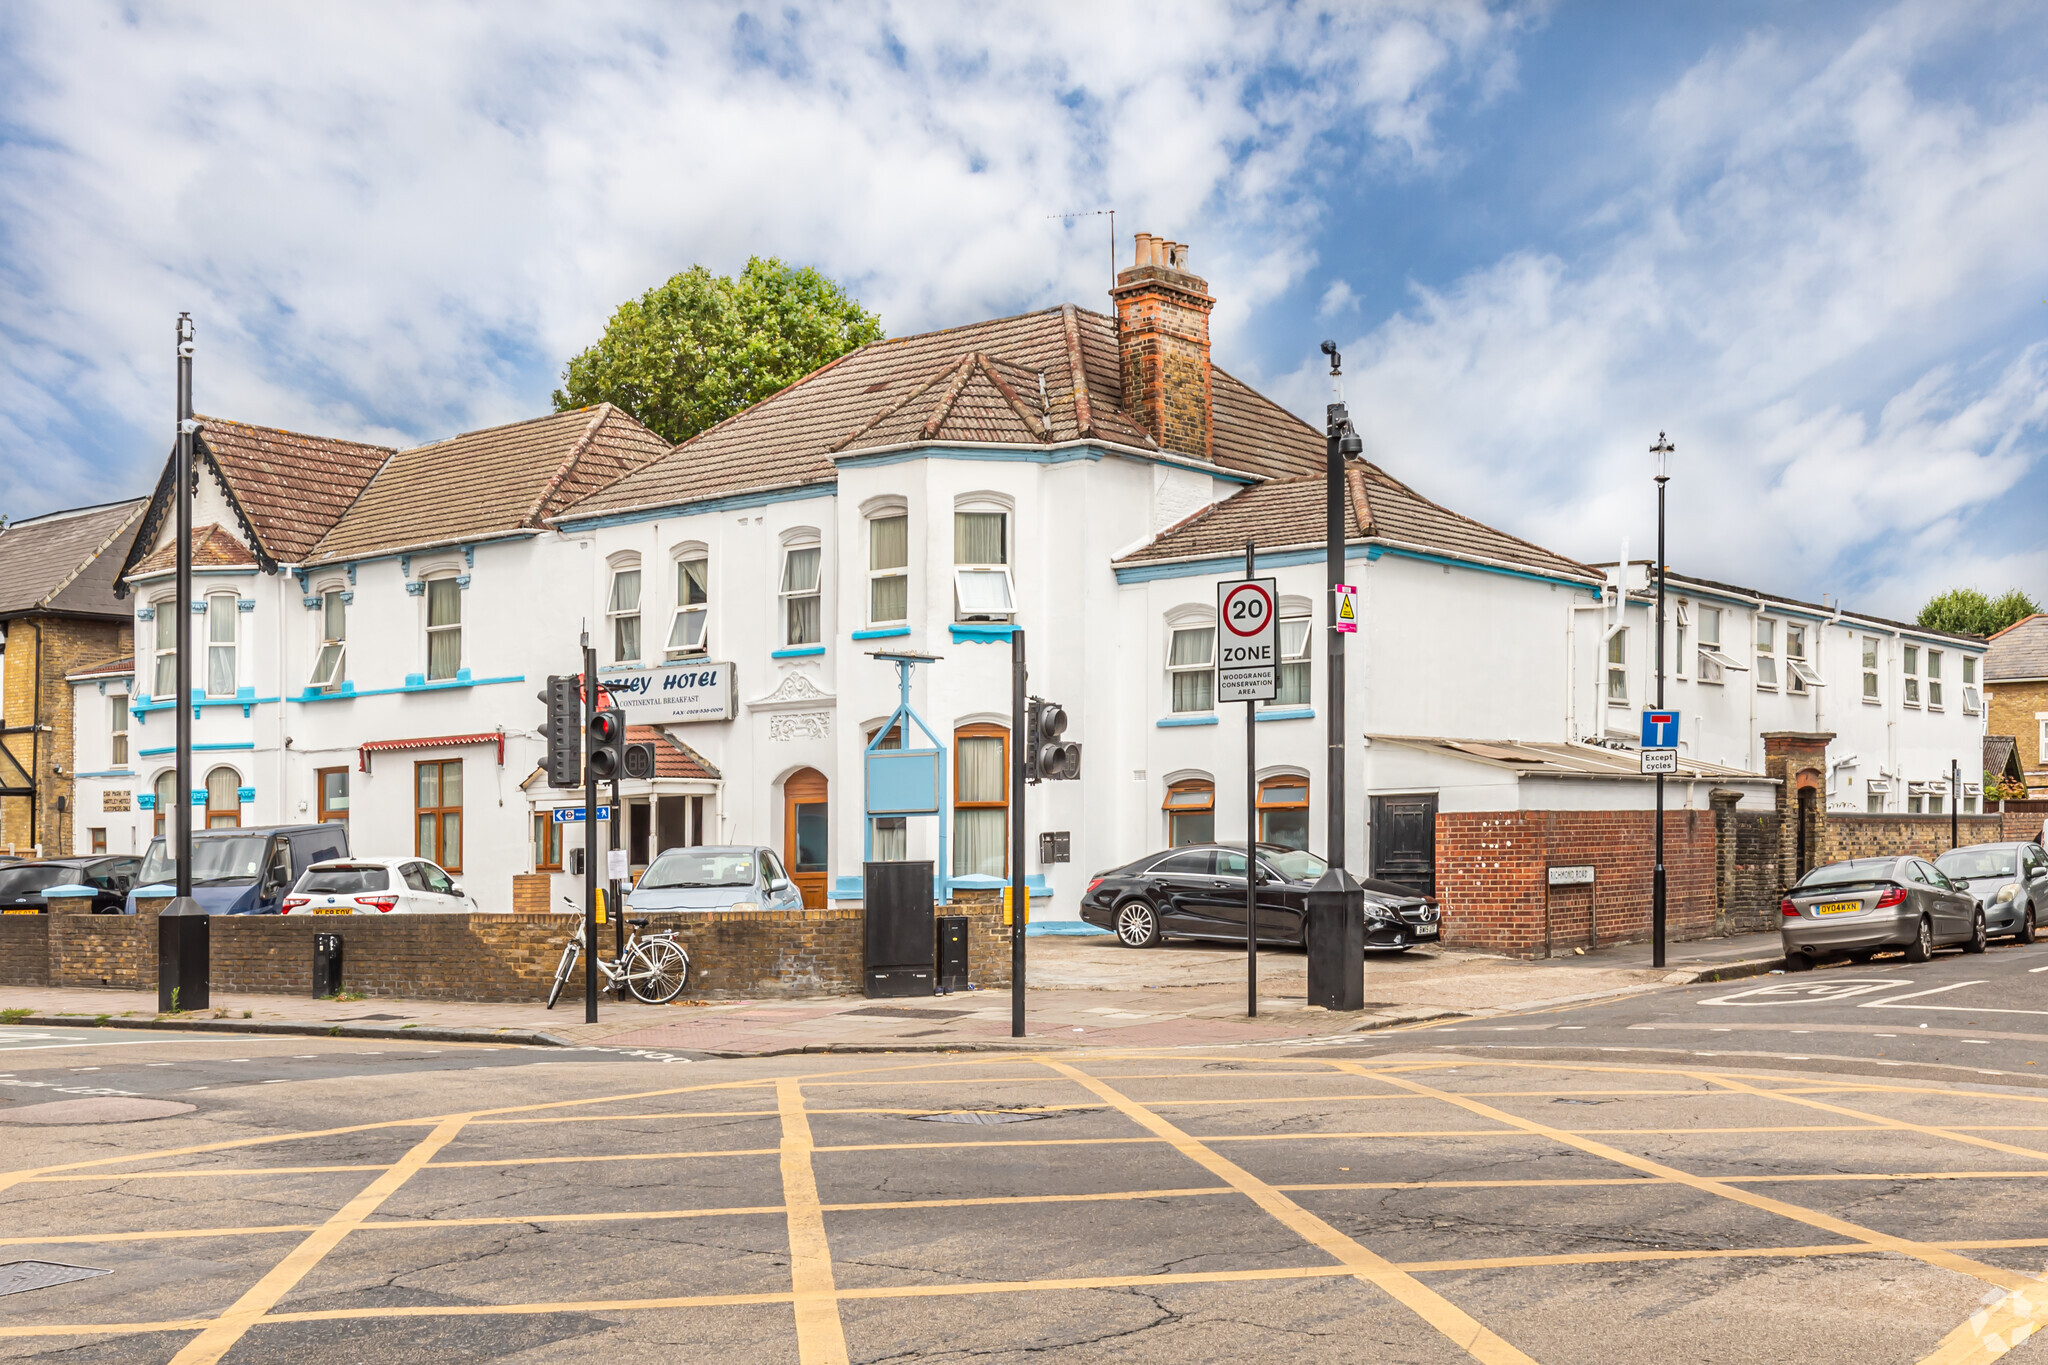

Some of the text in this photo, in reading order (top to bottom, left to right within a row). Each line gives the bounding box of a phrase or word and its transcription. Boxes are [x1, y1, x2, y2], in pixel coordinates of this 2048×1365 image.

[1232, 599, 1263, 619] 20
[1223, 645, 1271, 662] ZONE
[1222, 671, 1272, 680] WOODGRANGE
[1221, 680, 1273, 688] CONSERVATION
[620, 697, 662, 708] CONTINENTAL
[663, 695, 700, 705] BREAKFAST
[1645, 754, 1673, 762] Except
[1646, 762, 1672, 771] cycles
[1576, 869, 1588, 879] ROAD
